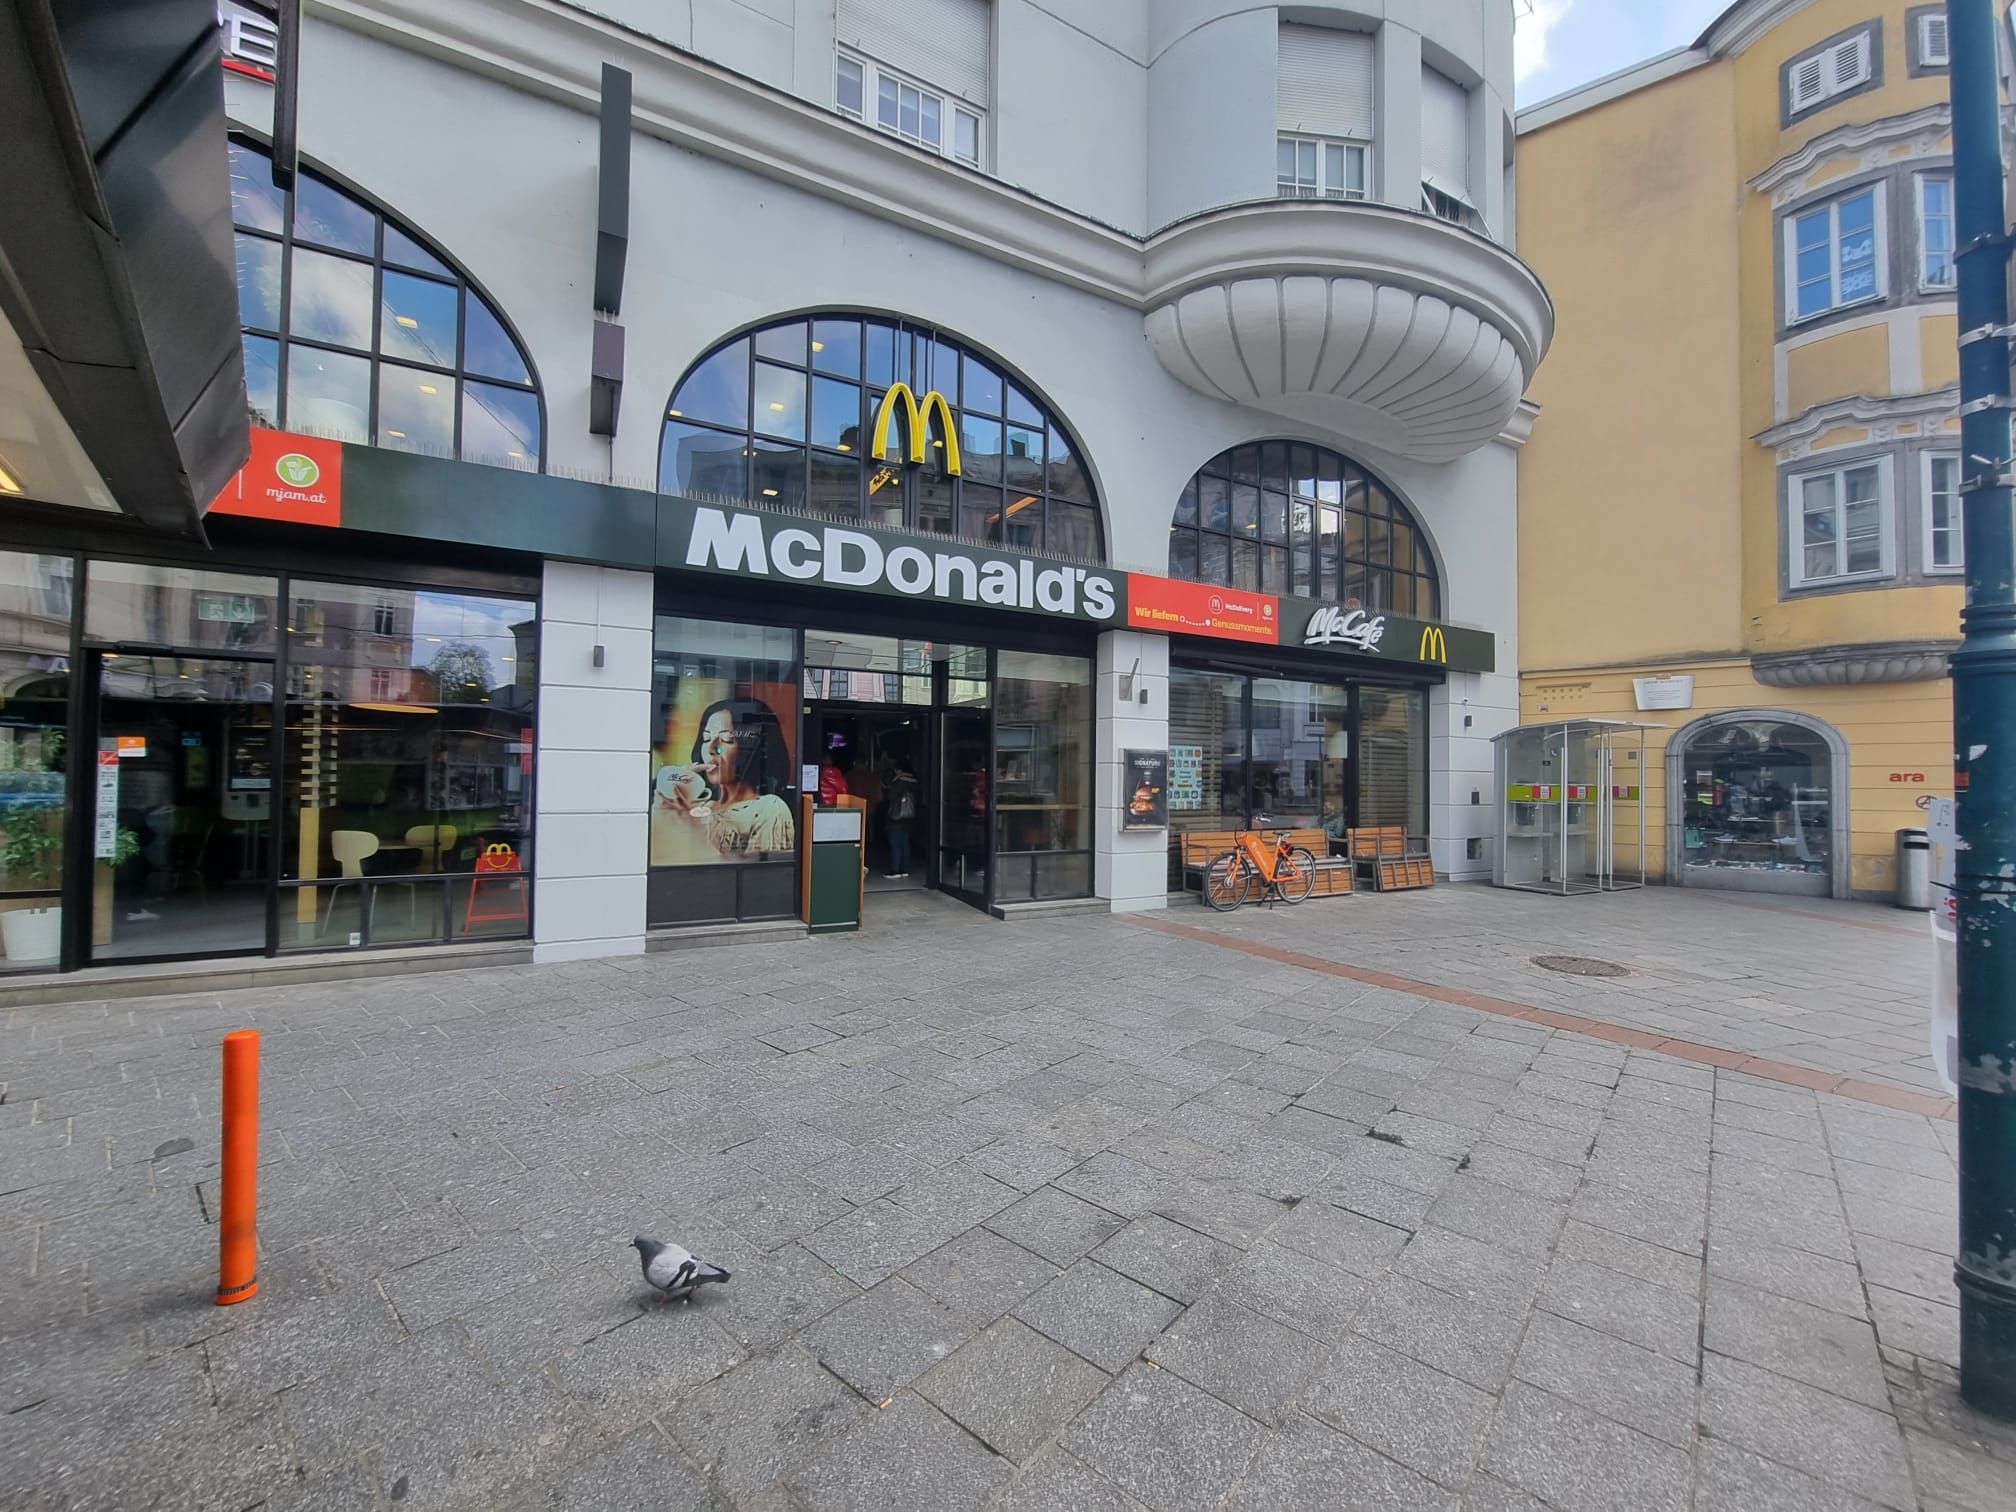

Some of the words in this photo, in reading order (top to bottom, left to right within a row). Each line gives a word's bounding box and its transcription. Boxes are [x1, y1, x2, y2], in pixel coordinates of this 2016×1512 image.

[266, 487, 327, 504] mjam.at
[685, 506, 1116, 619] McDonald's
[1135, 606, 1151, 618] Wir
[1151, 608, 1179, 622] liefern
[1304, 606, 1386, 652] McCafé
[1888, 772, 1925, 783] ara
